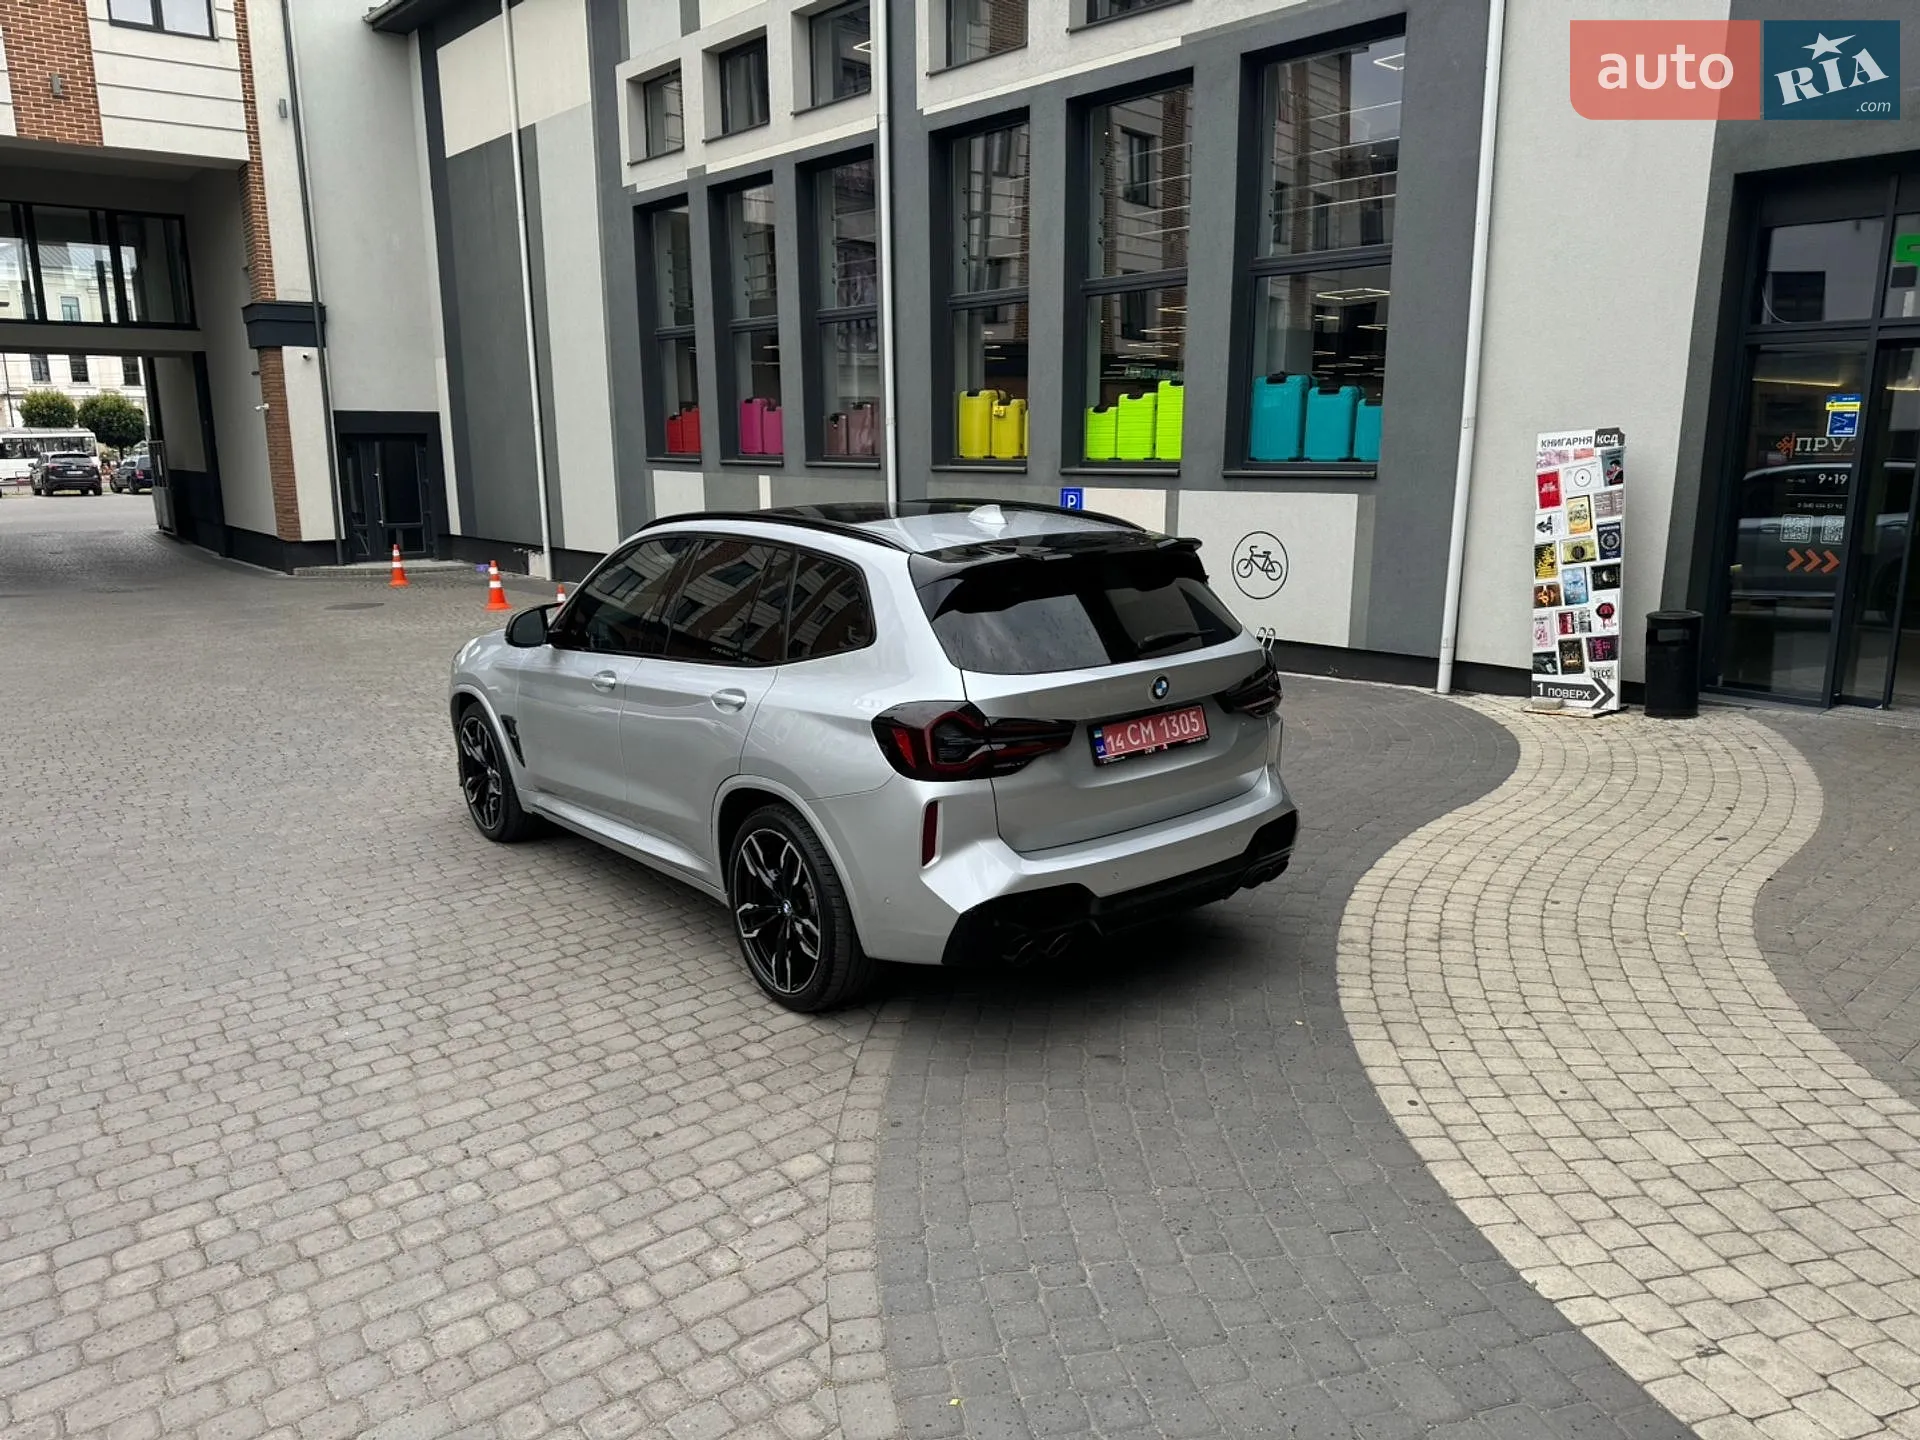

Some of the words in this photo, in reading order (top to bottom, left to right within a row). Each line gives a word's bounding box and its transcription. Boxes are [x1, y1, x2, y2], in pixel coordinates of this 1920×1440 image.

[1541, 436, 1593, 448] КНИГАРНЯ
[1597, 434, 1619, 445] КСД
[1067, 494, 1077, 509] P
[1537, 683, 1544, 696] 1
[1547, 687, 1591, 700] ПОВЕРХ
[1106, 733, 1125, 752] 14
[1127, 720, 1156, 745] CM
[1160, 711, 1200, 739] 1305
